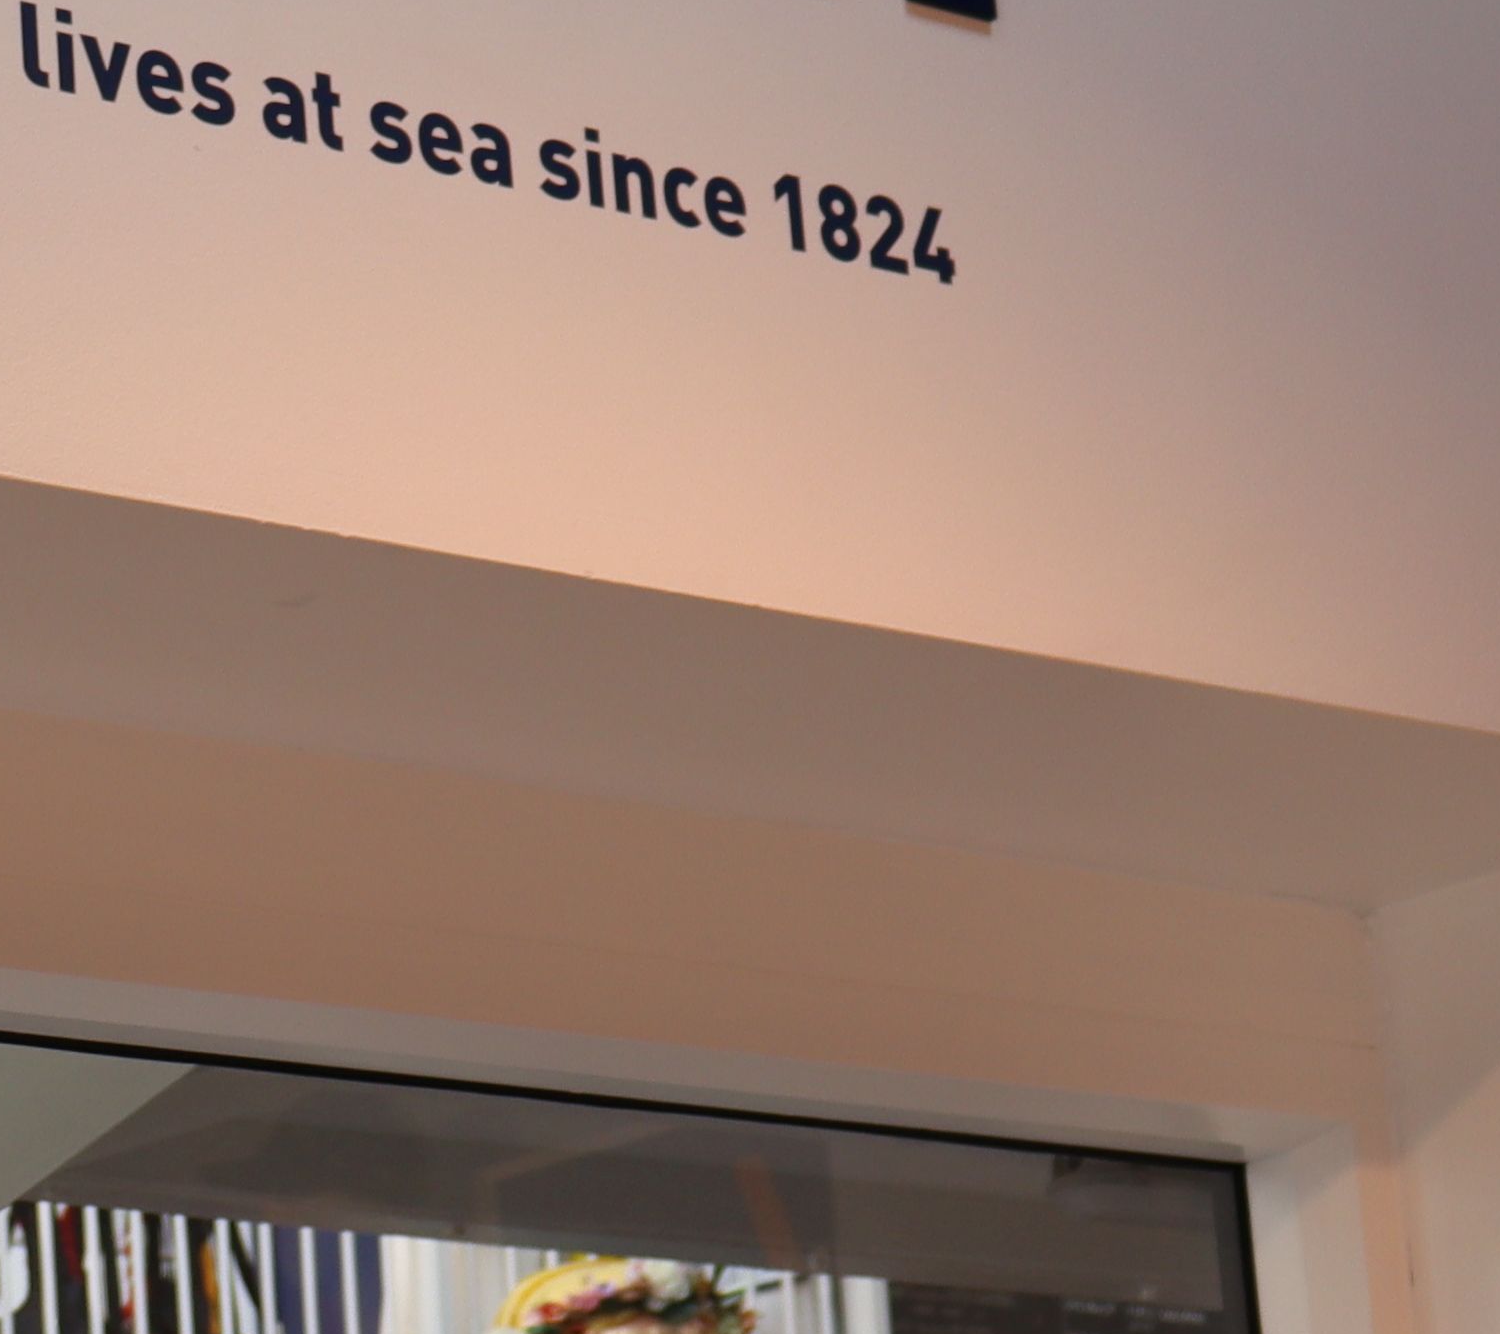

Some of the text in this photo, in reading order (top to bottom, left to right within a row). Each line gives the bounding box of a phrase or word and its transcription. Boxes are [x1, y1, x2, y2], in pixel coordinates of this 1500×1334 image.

[19, 0, 235, 126] lives
[262, 70, 344, 152] at
[369, 97, 513, 188] sea
[539, 128, 747, 237] since
[773, 173, 957, 285] 1824
